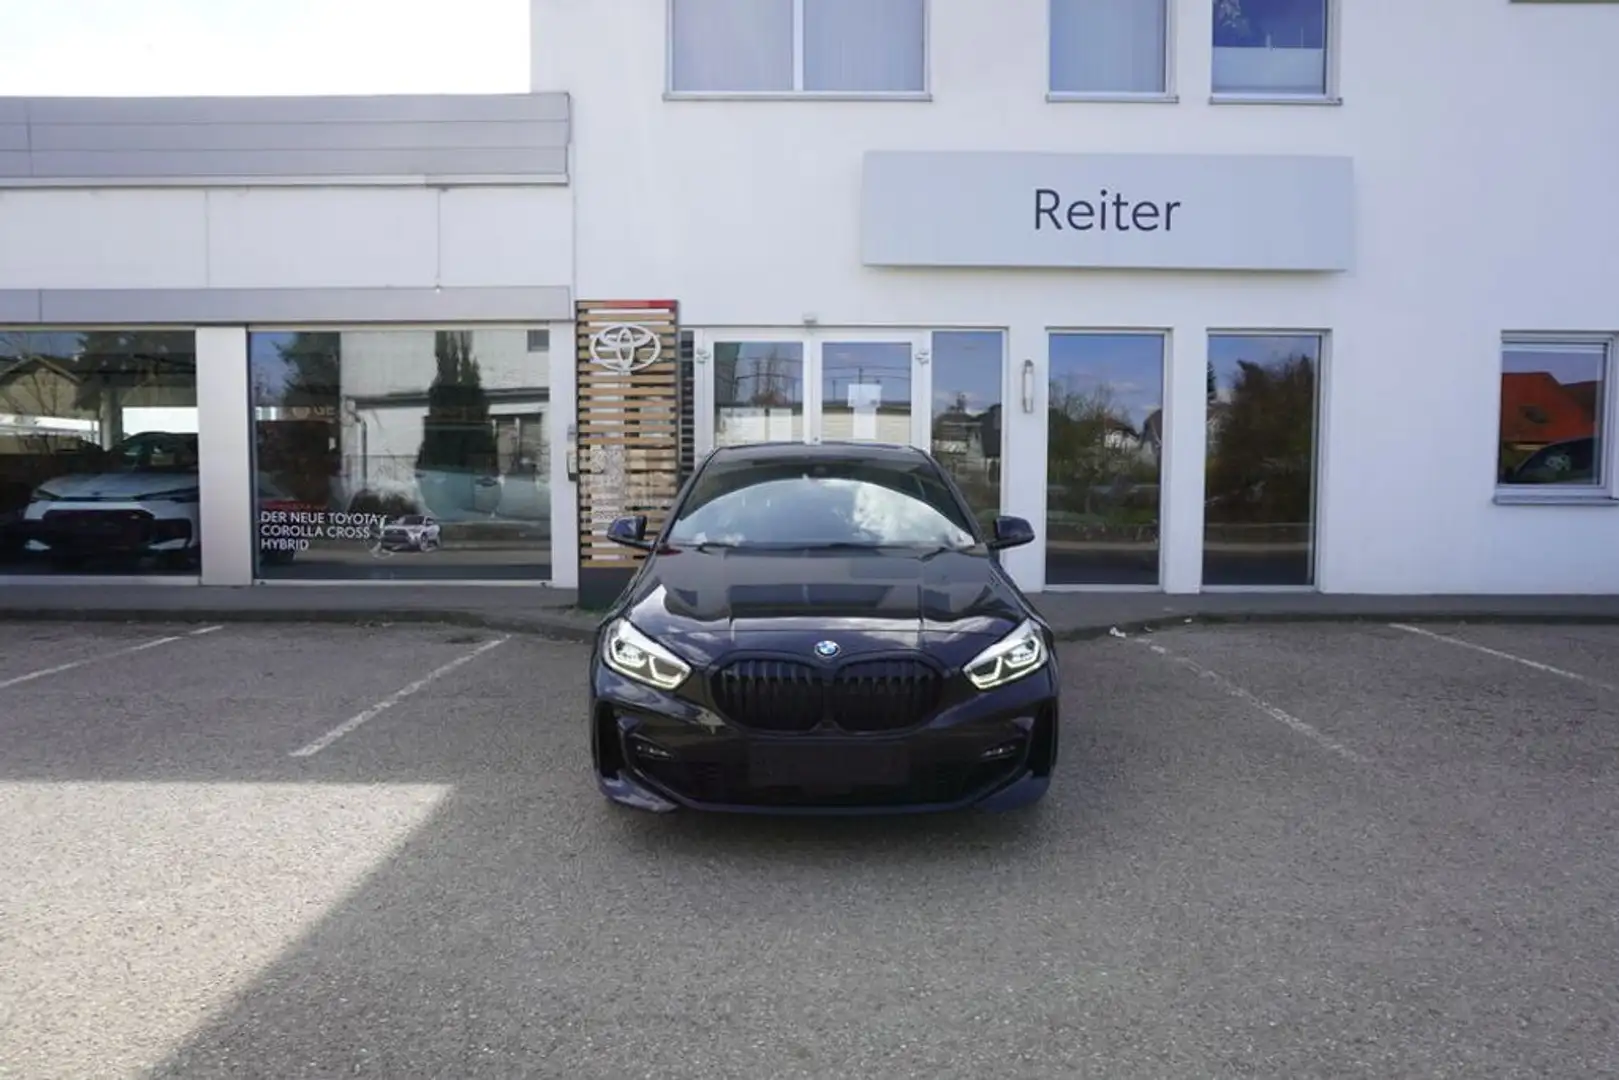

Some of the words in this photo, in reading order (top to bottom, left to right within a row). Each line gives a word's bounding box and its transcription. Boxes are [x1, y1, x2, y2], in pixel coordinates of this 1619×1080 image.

[1035, 188, 1181, 231] Reiter
[260, 511, 287, 523] DER
[290, 512, 325, 524] NEUE
[327, 513, 378, 525] TOYOTA
[260, 525, 324, 537] COROLLA
[326, 526, 370, 539] CROSS
[260, 538, 309, 551] HYBRID
